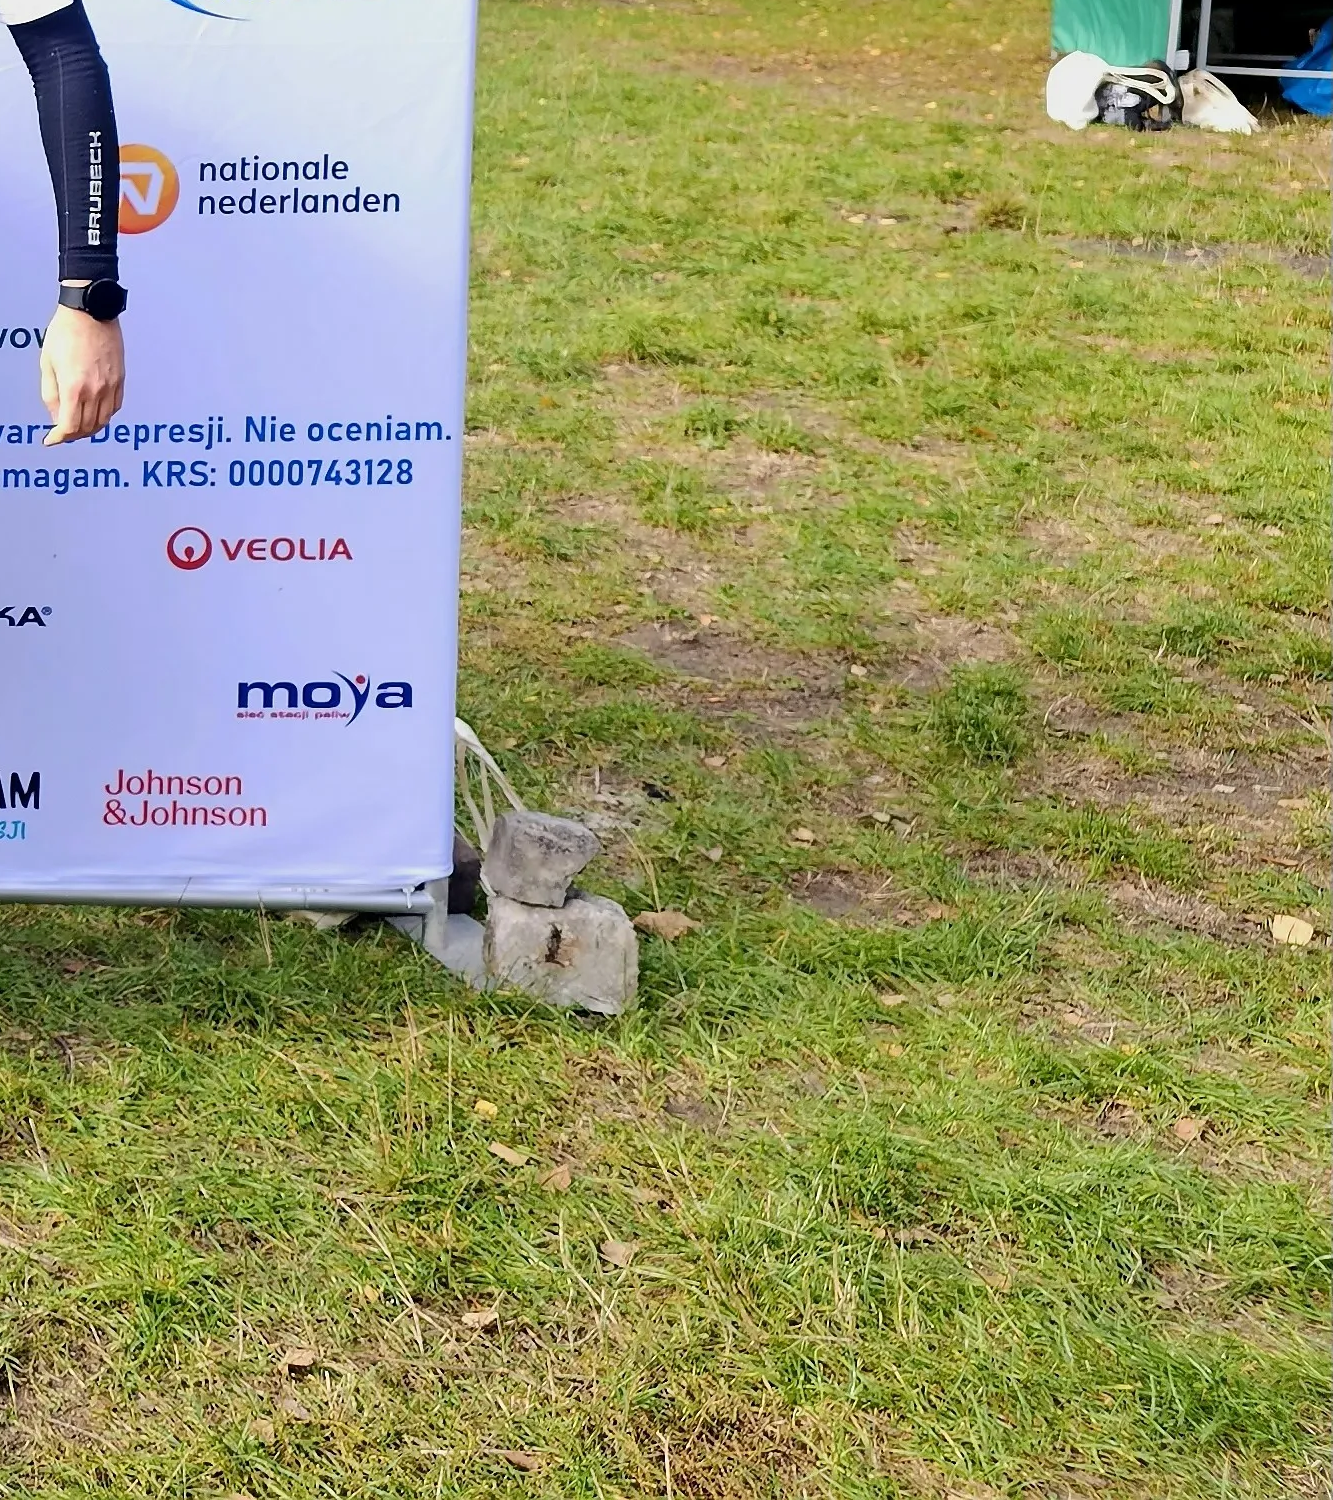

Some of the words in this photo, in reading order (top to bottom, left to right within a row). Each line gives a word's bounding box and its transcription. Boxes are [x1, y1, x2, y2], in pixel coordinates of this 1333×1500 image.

[199, 153, 350, 183] nationale
[86, 130, 103, 246] BRUBECK
[198, 186, 401, 216] nederlanden
[244, 415, 296, 443] Nie
[307, 414, 453, 443] oceniam.
[142, 460, 217, 487] KRS:
[228, 459, 414, 486] 0000743128
[220, 537, 353, 562] VEOLIA
[237, 669, 414, 728] moya
[104, 769, 243, 796] Johnson
[102, 798, 268, 828] &Johnson
